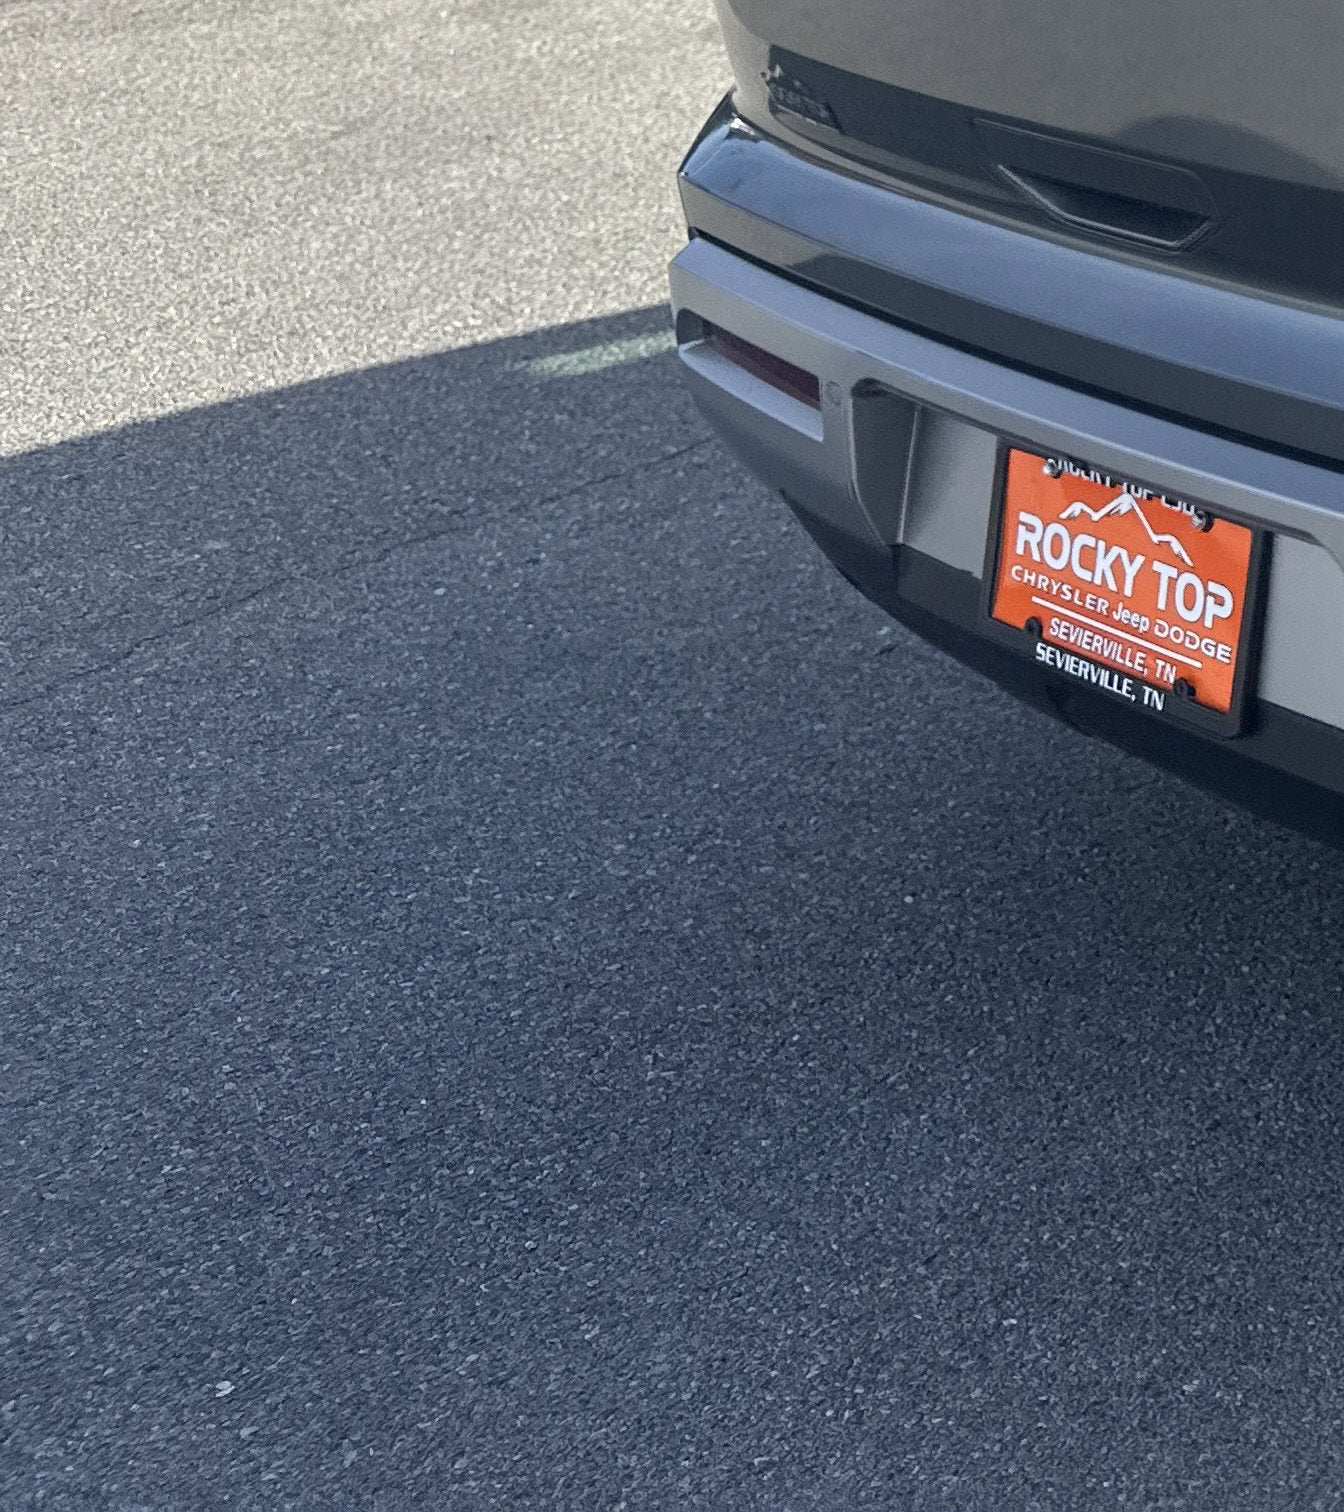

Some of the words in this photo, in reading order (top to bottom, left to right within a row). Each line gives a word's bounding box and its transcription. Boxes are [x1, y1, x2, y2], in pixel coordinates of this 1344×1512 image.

[1015, 510, 1145, 598] ROCKY
[1152, 559, 1234, 629] TOP
[1010, 564, 1110, 616] CHRYSLER
[1112, 601, 1150, 634] Jeep
[1153, 618, 1232, 665] DODGE
[1049, 617, 1148, 678] SEVIERVILLE,
[1154, 658, 1177, 685] TN
[1035, 642, 1136, 702] SEVIERVILLE,
[1142, 684, 1167, 711] TN
